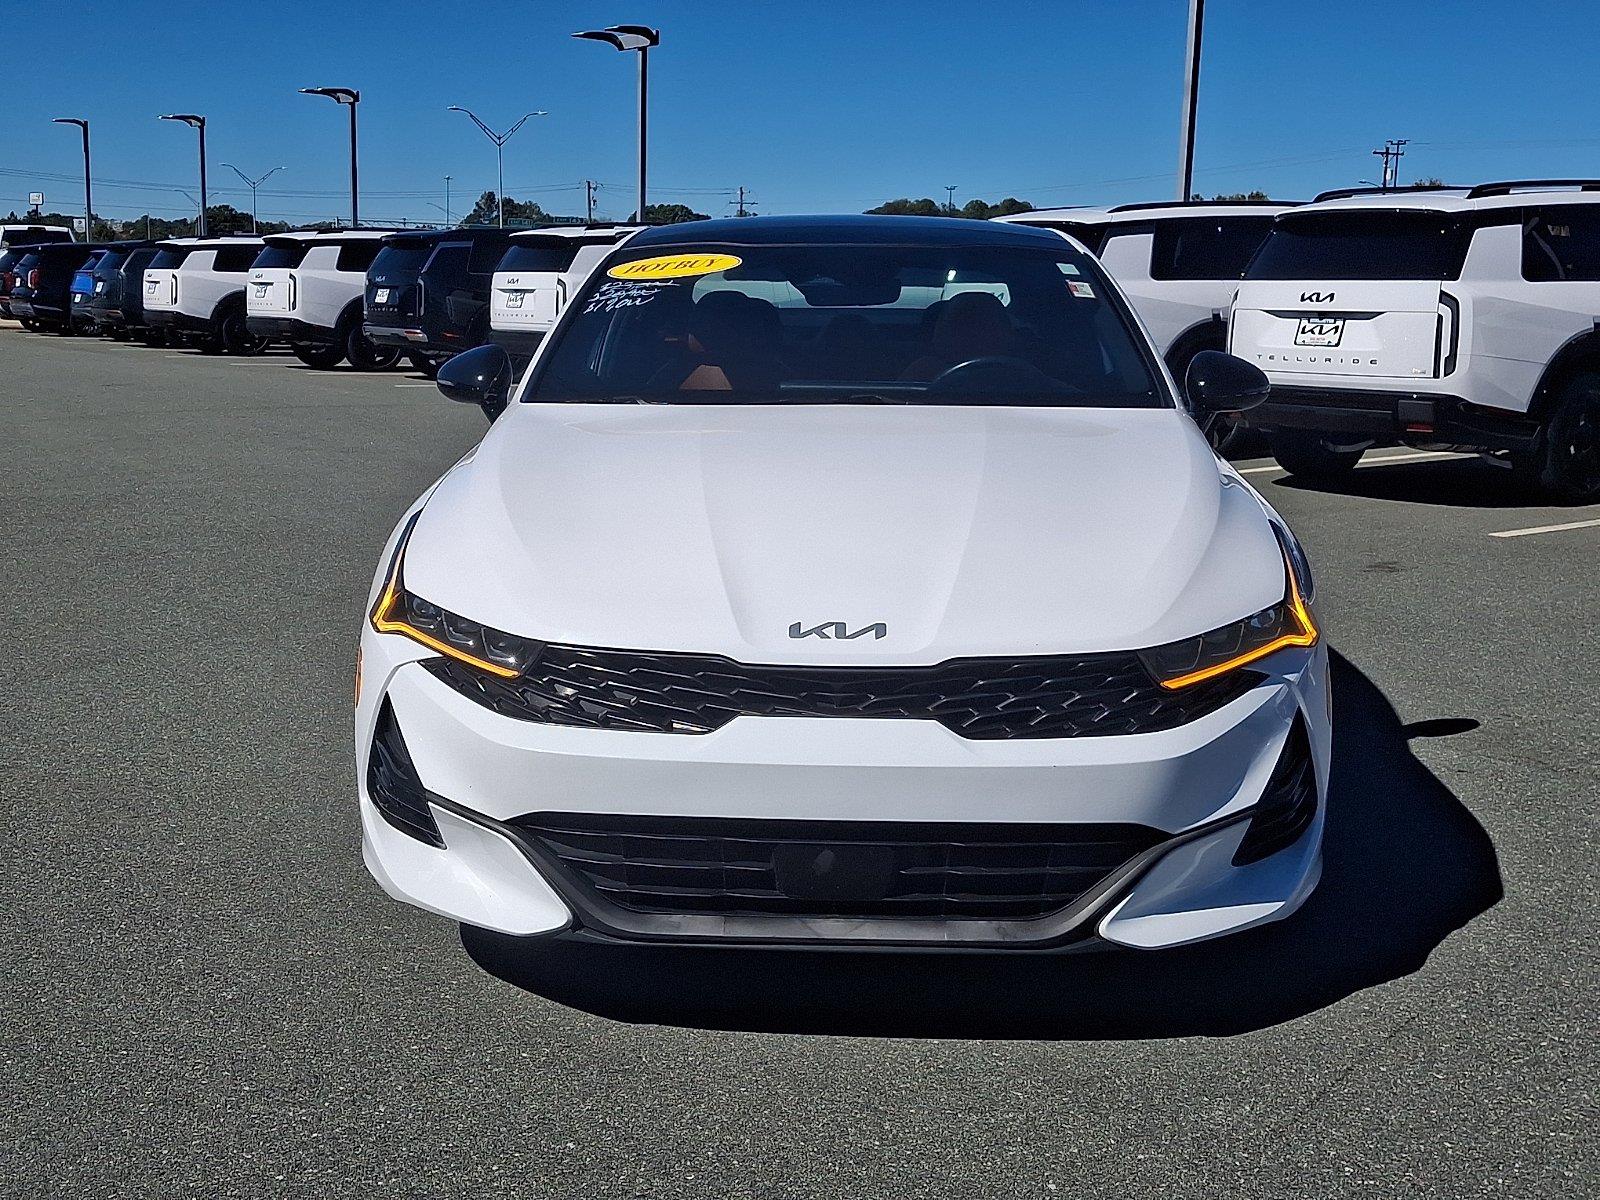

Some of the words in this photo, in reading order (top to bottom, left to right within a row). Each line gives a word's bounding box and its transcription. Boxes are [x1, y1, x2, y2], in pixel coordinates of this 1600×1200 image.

[623, 261, 676, 275] HOT
[673, 258, 721, 270] BUY
[1257, 354, 1378, 365] TELLURIDE
[789, 621, 887, 640] KIA
